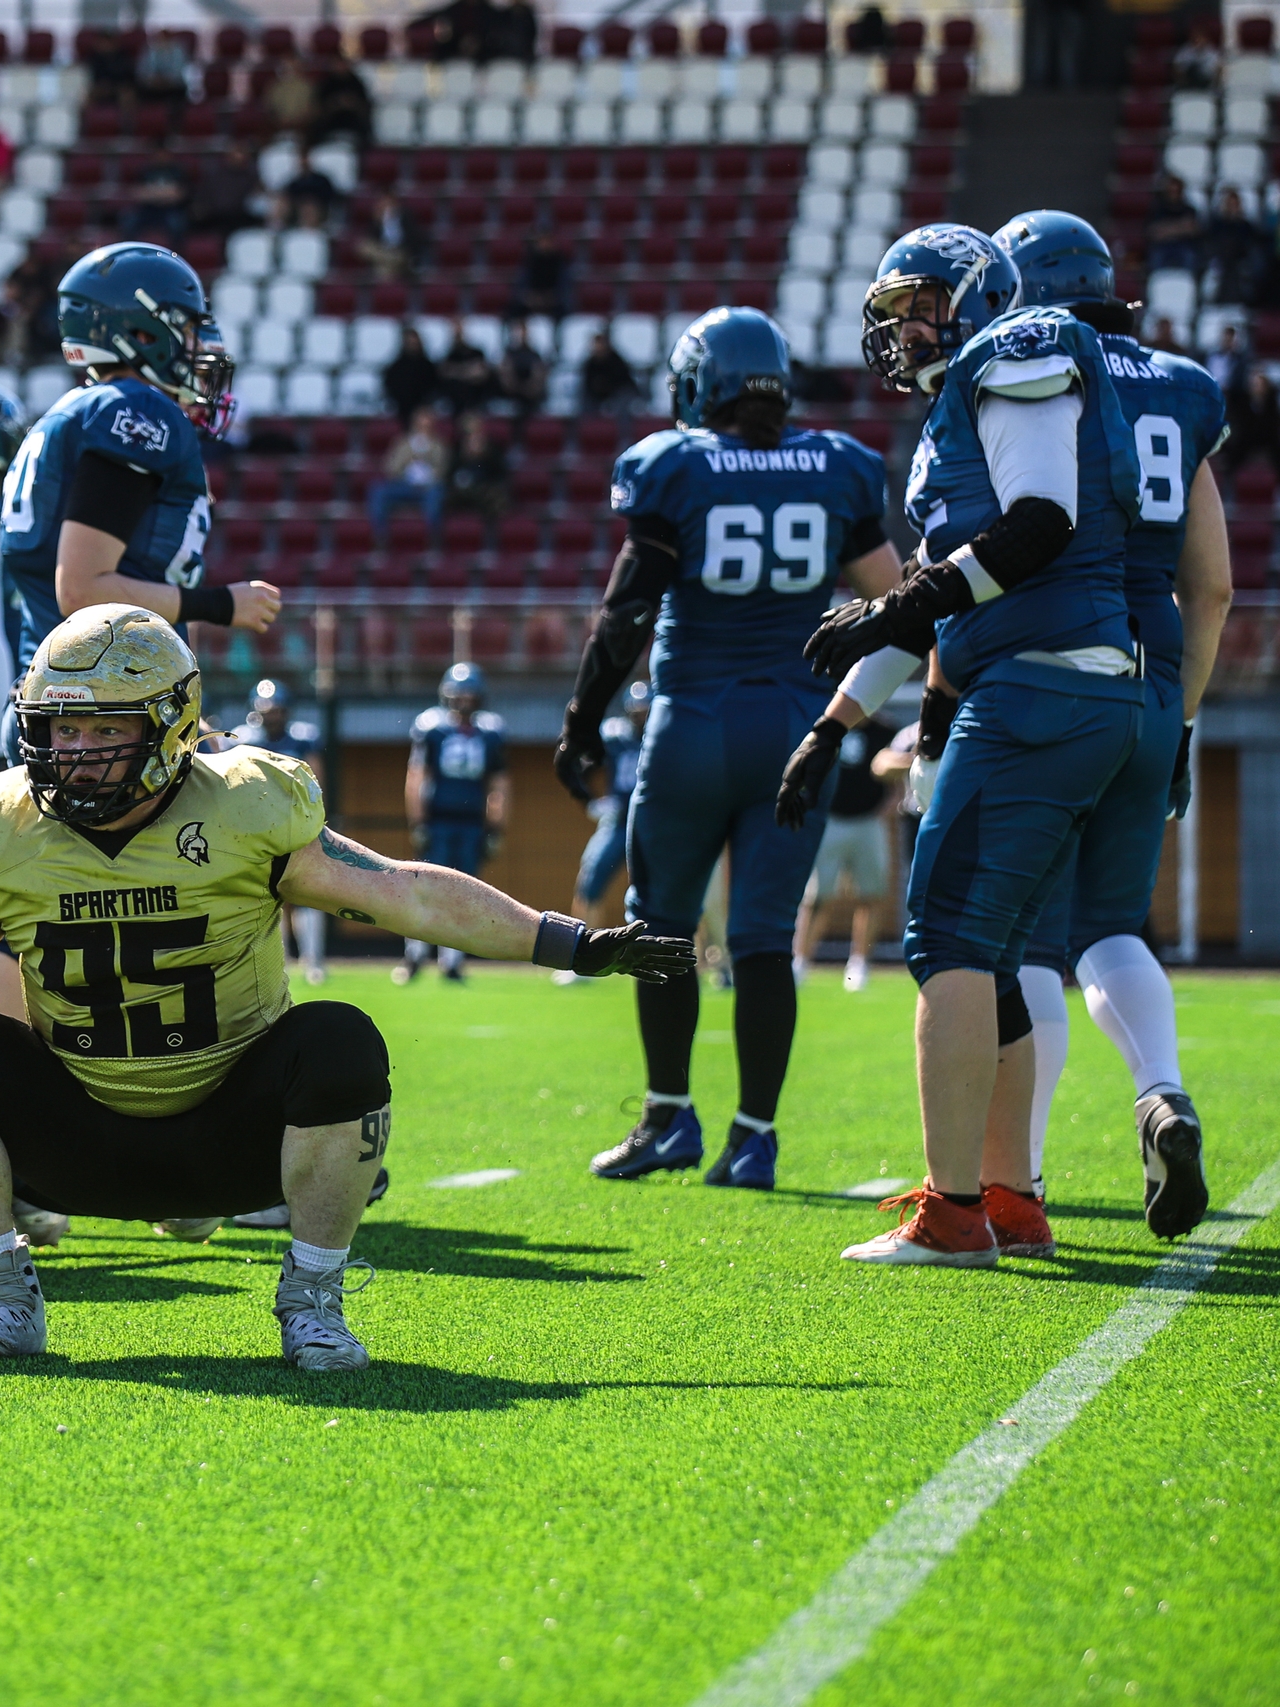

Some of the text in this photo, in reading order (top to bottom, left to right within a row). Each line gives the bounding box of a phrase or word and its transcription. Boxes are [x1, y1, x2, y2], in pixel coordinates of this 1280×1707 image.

[704, 449, 827, 473] VORONKOV
[701, 502, 828, 596] 69
[59, 885, 179, 921] SPARTANS
[34, 914, 219, 1058] 95
